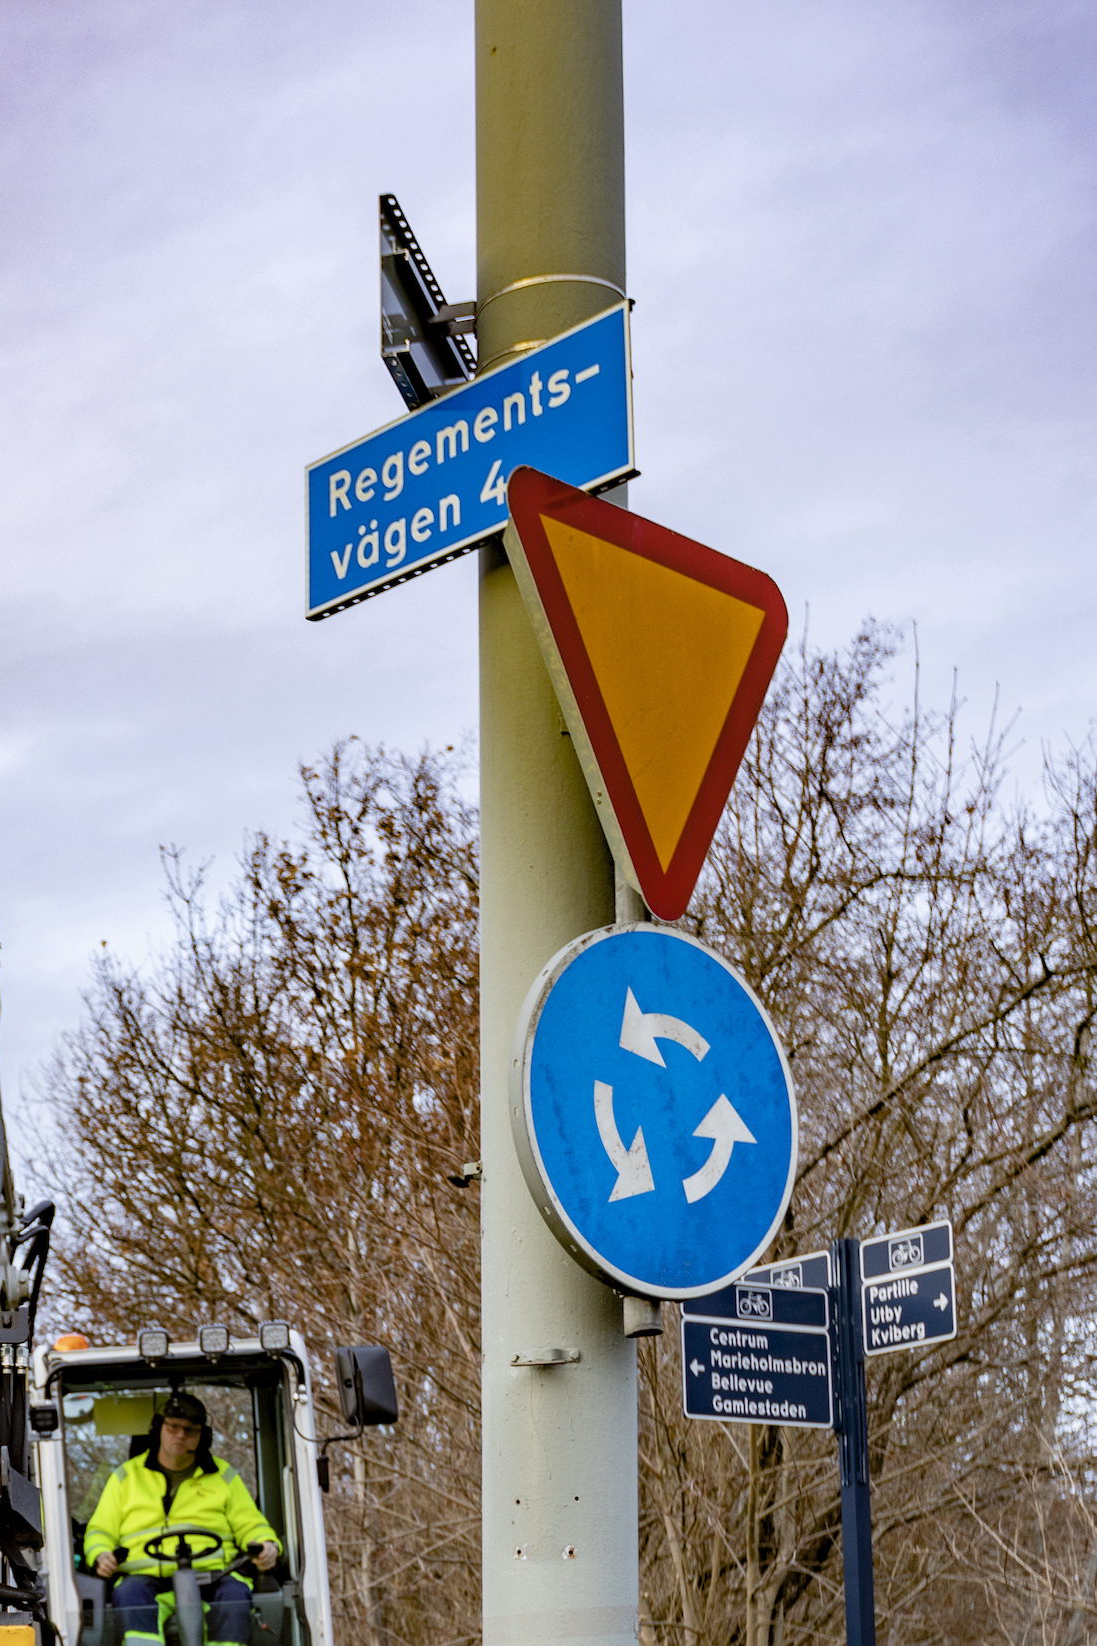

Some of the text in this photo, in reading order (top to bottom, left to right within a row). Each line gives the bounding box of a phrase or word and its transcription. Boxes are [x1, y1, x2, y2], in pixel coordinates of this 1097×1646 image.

[329, 364, 599, 517] Regements-
[330, 495, 461, 580] vägen
[869, 1278, 919, 1303] Partille
[870, 1306, 903, 1325] Utby
[710, 1328, 768, 1350] Centrum
[871, 1322, 926, 1347] Kviberg
[710, 1350, 826, 1377] Marieholmsbron
[711, 1372, 773, 1394] Bellevue
[712, 1395, 807, 1419] Gamlestaden
